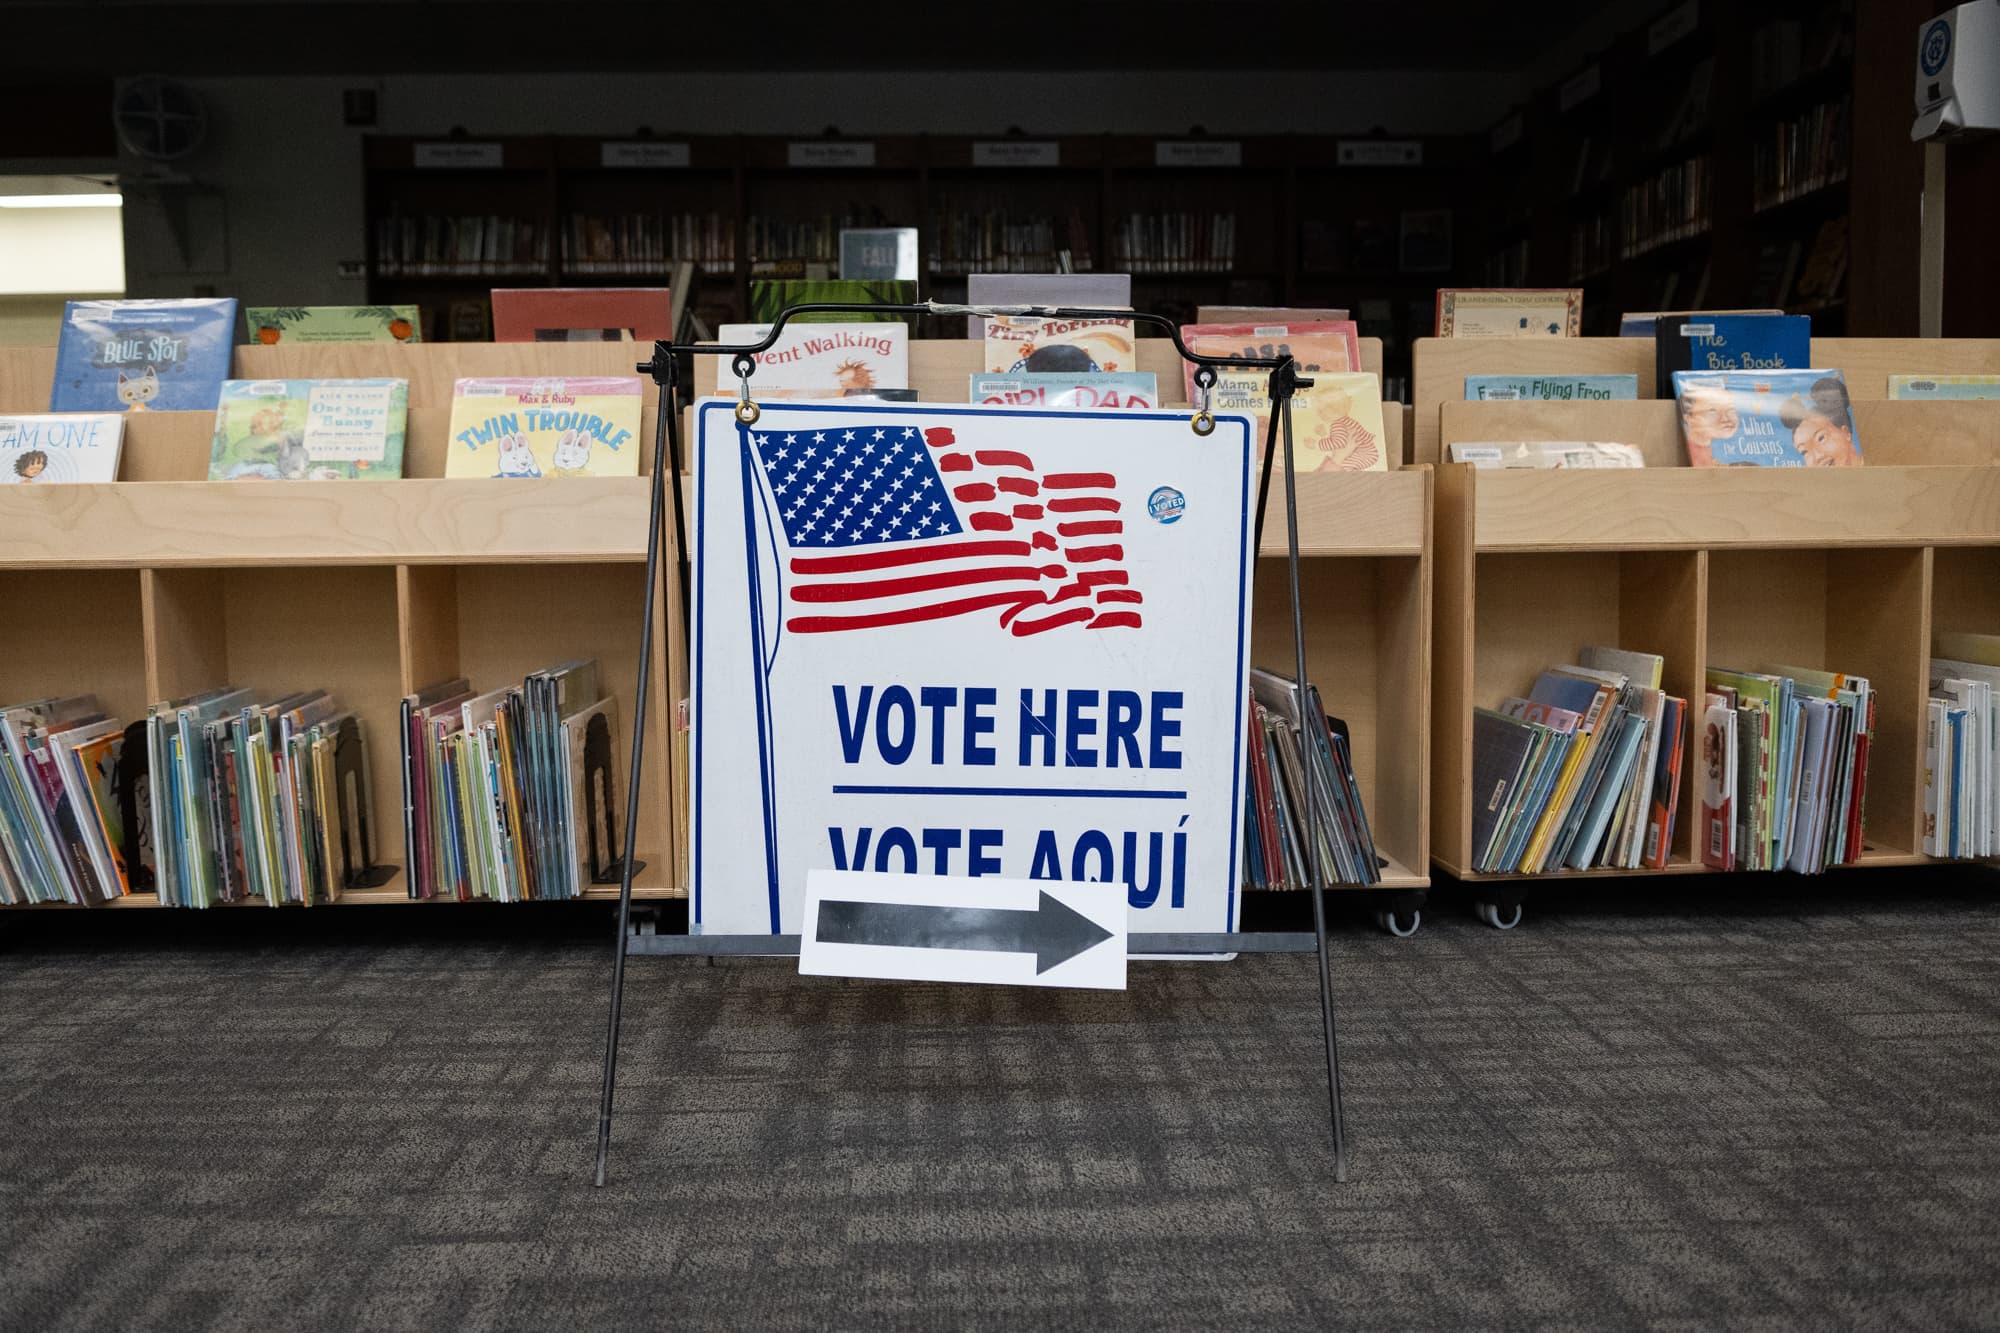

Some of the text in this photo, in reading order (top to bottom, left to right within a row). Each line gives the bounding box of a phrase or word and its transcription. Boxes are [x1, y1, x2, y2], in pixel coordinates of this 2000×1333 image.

[103, 340, 144, 363] BLUE
[803, 331, 893, 356] Walking
[1706, 351, 1787, 369] Big Book
[1217, 379, 1258, 392] Mama
[1532, 379, 1572, 400] Flying
[312, 403, 341, 414] One
[518, 394, 538, 404] Max
[552, 393, 576, 406] Ruby
[1217, 397, 1264, 409] Comes
[2, 420, 104, 448] AM ONE
[456, 409, 632, 452] TWIN TROUBLE
[1741, 416, 1774, 436] When
[1738, 436, 1784, 455] Cousins
[1154, 497, 1184, 512] VOTED
[832, 685, 1184, 769] VOTE HERE
[828, 815, 1190, 909] VOTE AQUÍ
